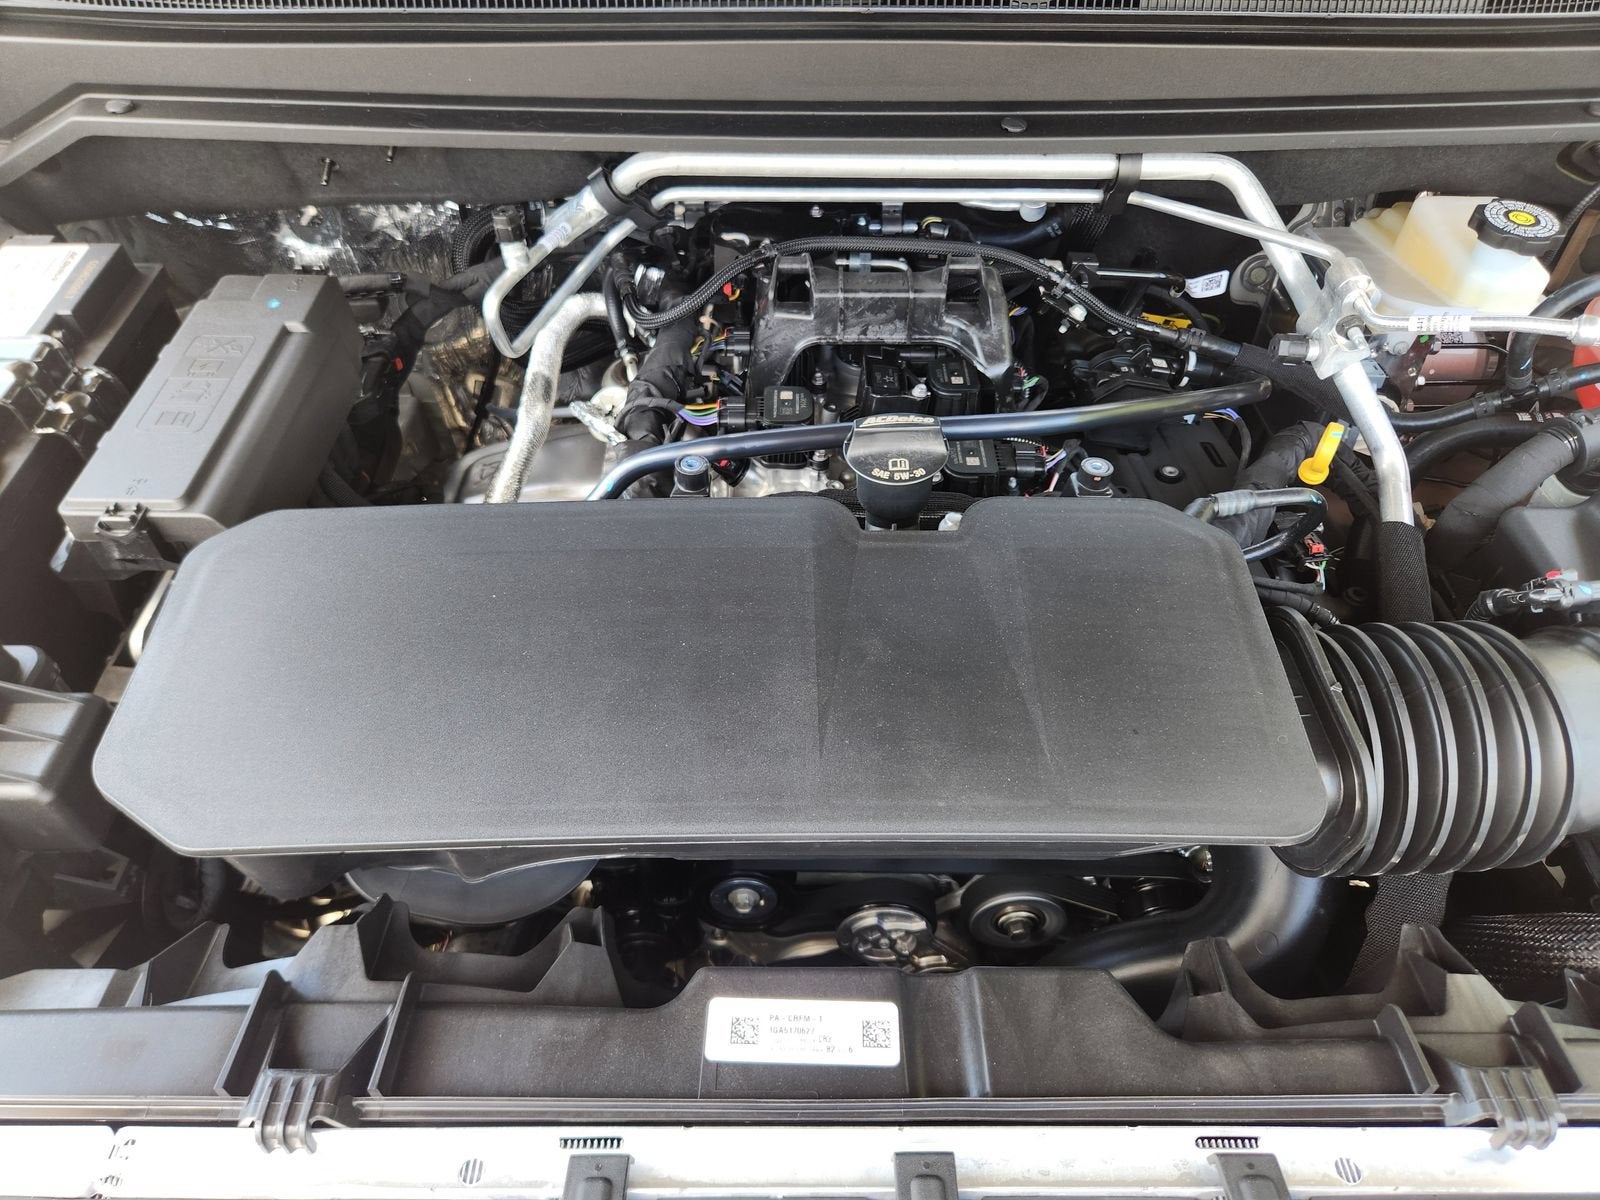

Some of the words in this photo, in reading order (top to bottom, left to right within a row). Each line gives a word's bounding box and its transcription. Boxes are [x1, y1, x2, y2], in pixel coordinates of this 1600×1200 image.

[859, 415, 935, 427] ACDelco
[871, 467, 891, 479] SAE
[893, 467, 926, 481] 5W-30
